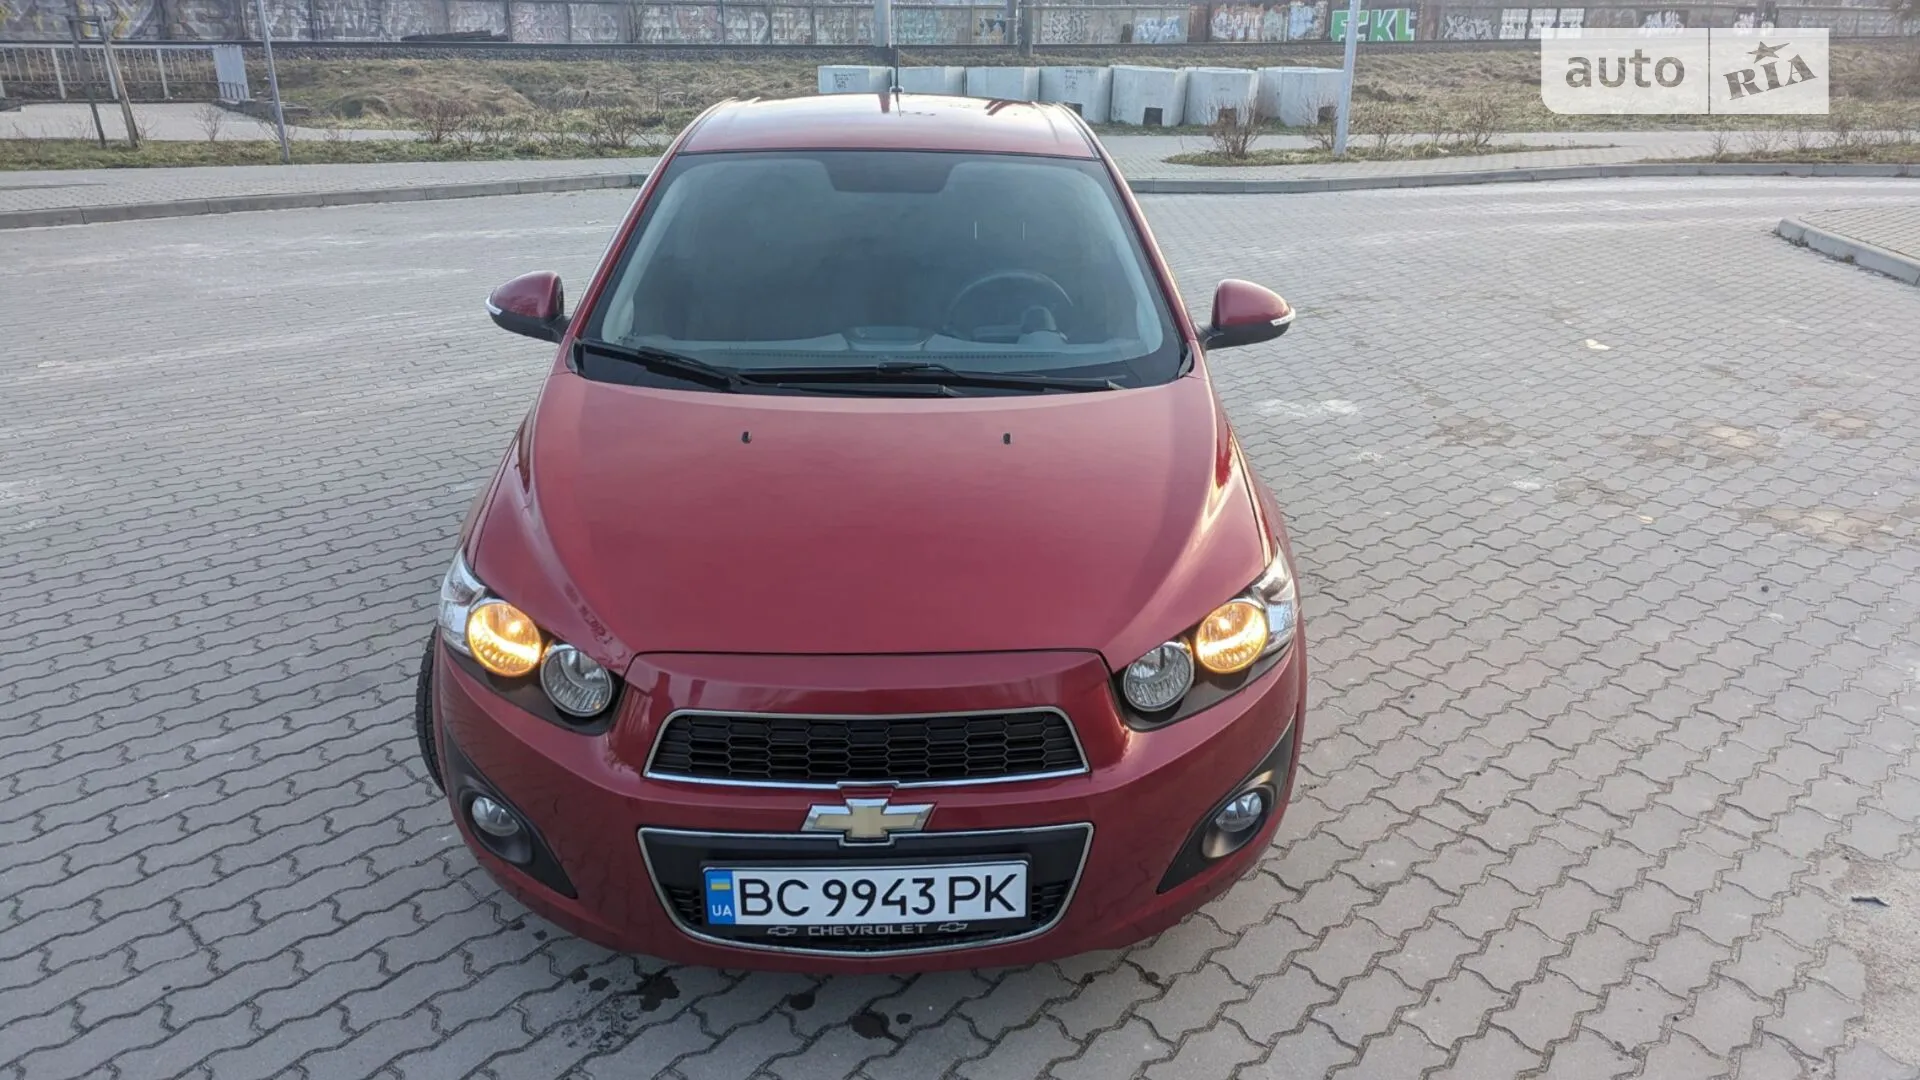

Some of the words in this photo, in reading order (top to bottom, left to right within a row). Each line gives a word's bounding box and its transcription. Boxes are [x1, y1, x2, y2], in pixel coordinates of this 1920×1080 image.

[739, 878, 810, 917] BC
[822, 877, 935, 917] 9943
[948, 873, 1018, 914] PK
[712, 904, 733, 917] UA
[807, 924, 927, 936] CHEVROLET
